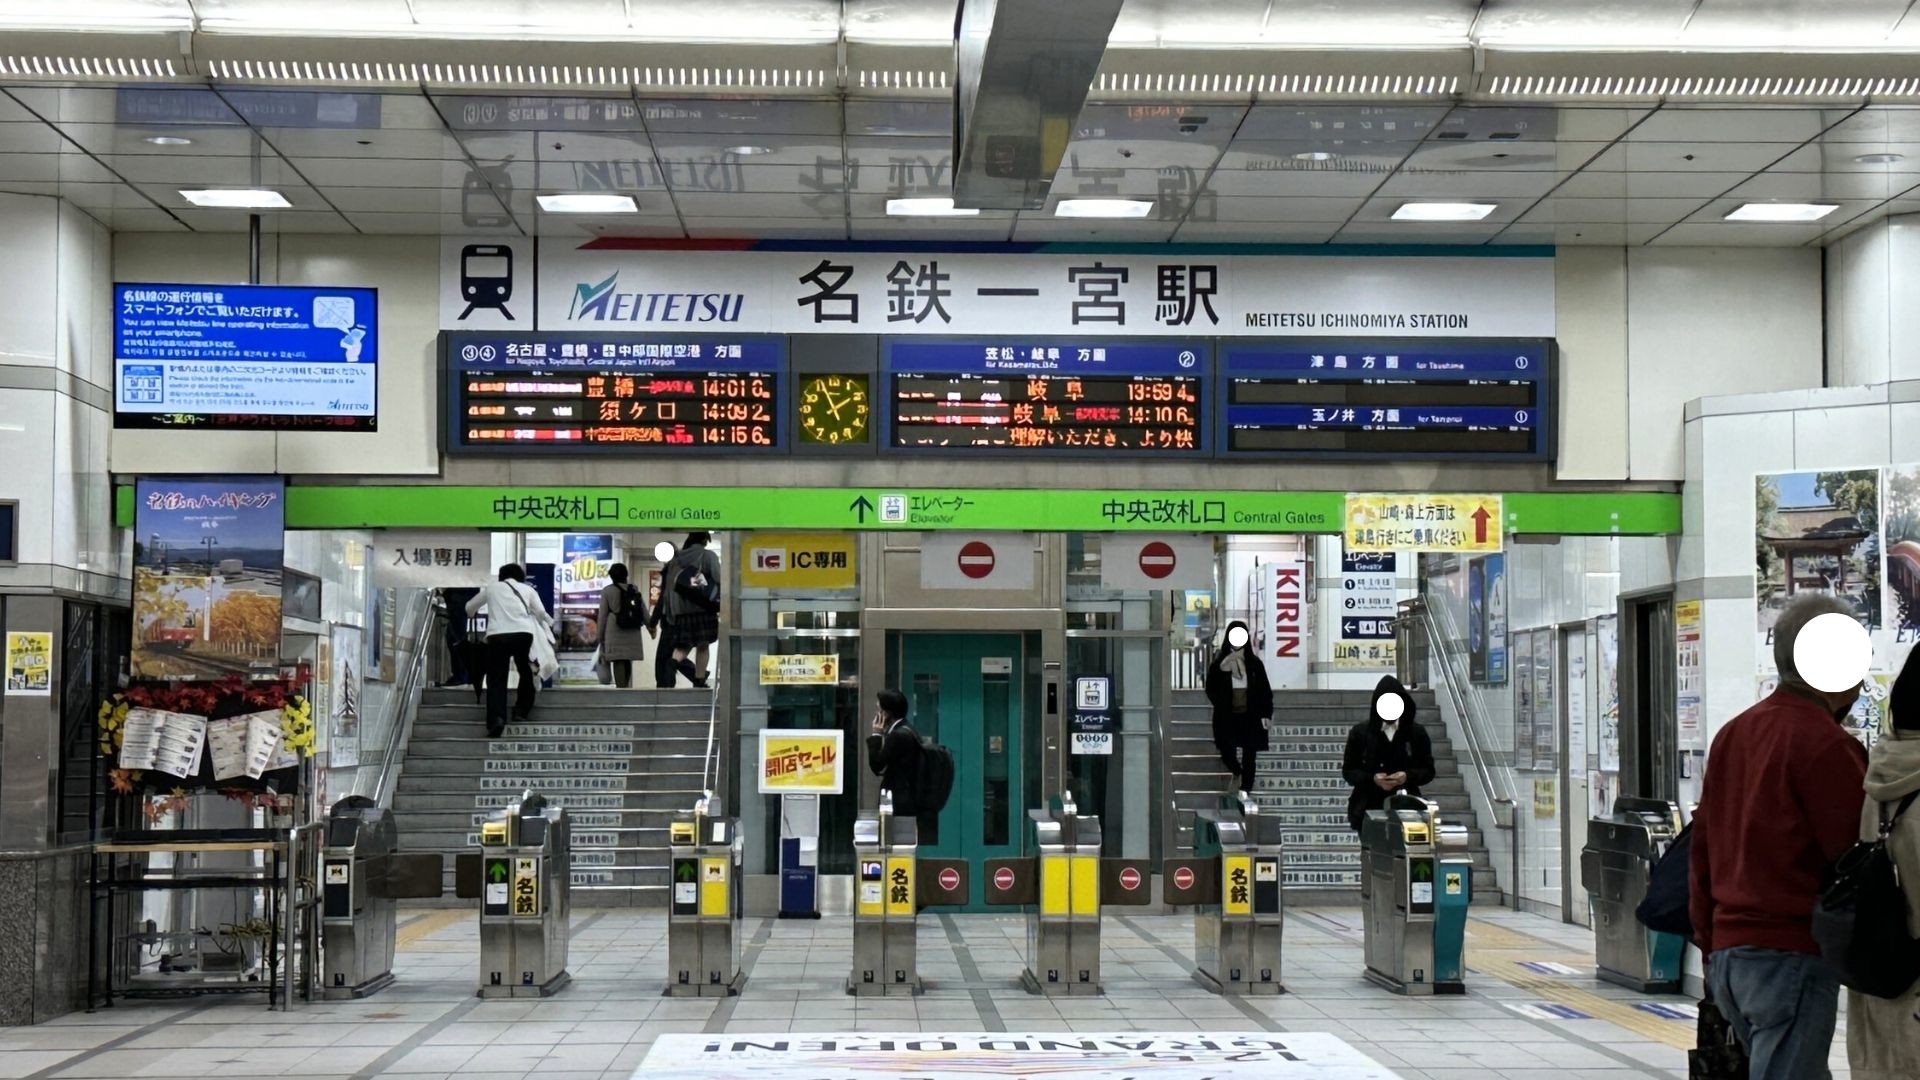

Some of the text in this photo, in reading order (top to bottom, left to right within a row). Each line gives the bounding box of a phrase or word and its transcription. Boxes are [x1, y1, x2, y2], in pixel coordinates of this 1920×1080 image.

[568, 269, 744, 322] MEITETSU
[797, 259, 1221, 326] 名鉄一宮駅
[1246, 312, 1468, 329] MEITETSU ICHINOMIYA STATION
[714, 344, 742, 358] 方面
[1077, 348, 1106, 361] 方面
[703, 380, 745, 397] 14:01
[1027, 380, 1084, 401] 岐阜
[1128, 383, 1172, 400] 13:59
[702, 403, 748, 420] 14:09
[1013, 403, 1061, 424] 岐阜
[1128, 406, 1172, 423] 14:10
[1312, 408, 1355, 422] 玉ノ井
[703, 426, 748, 443] 14:15
[493, 496, 620, 520] 中央改札口
[910, 496, 975, 511] エレベーター
[1102, 499, 1226, 523] 中央改札口
[628, 507, 720, 520] Central Gates
[1234, 511, 1325, 524] Central Gates
[393, 548, 472, 567] 入場専用
[791, 551, 847, 569] IC専用
[1276, 569, 1300, 658] KIRIN
[892, 867, 909, 904] 名鉄
[1231, 867, 1248, 904] 名鉄
[517, 877, 534, 913] 名鉄
